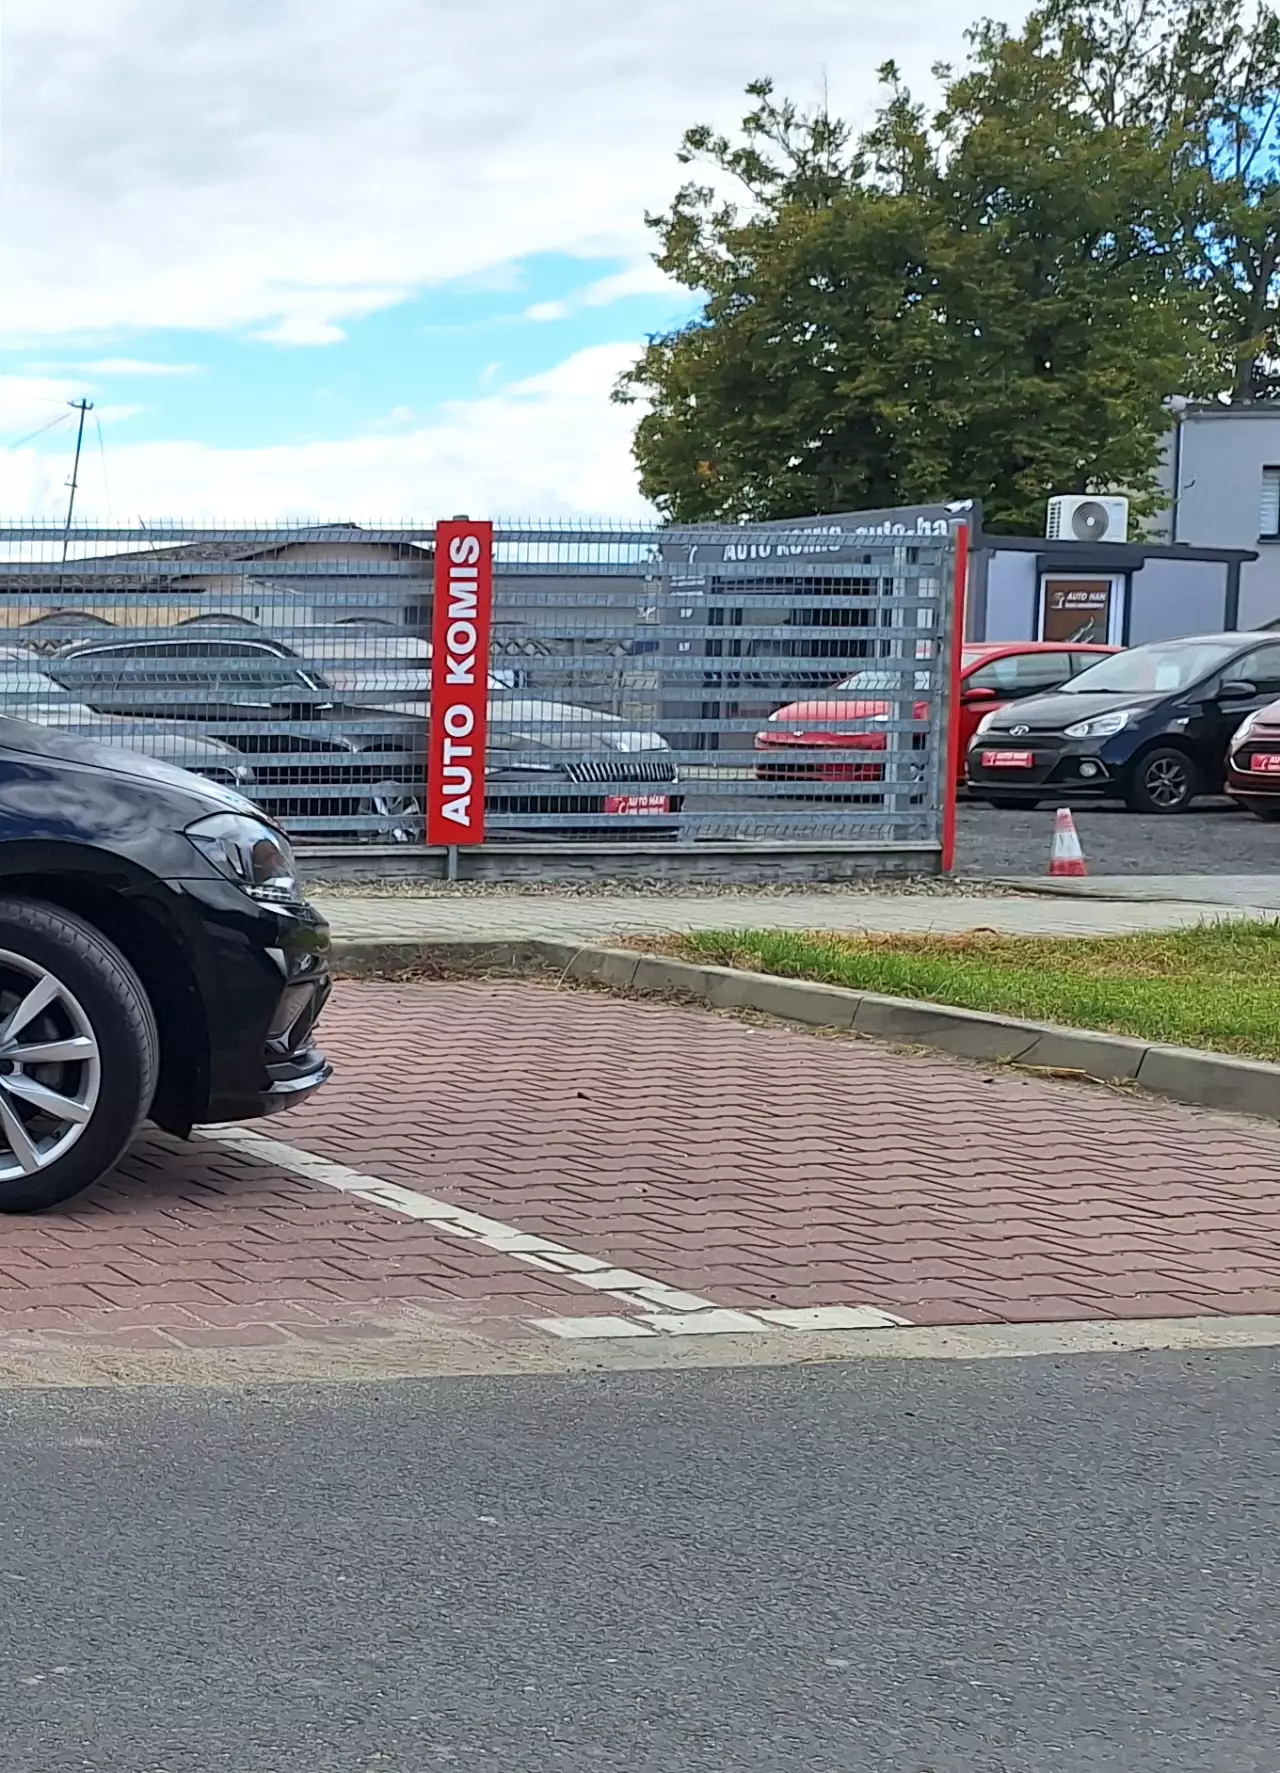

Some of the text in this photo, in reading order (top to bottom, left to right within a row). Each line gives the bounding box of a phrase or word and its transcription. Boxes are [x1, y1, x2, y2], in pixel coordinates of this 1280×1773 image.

[1066, 592, 1107, 600] AUTO HAN
[441, 535, 480, 827] AUTO KOMIS
